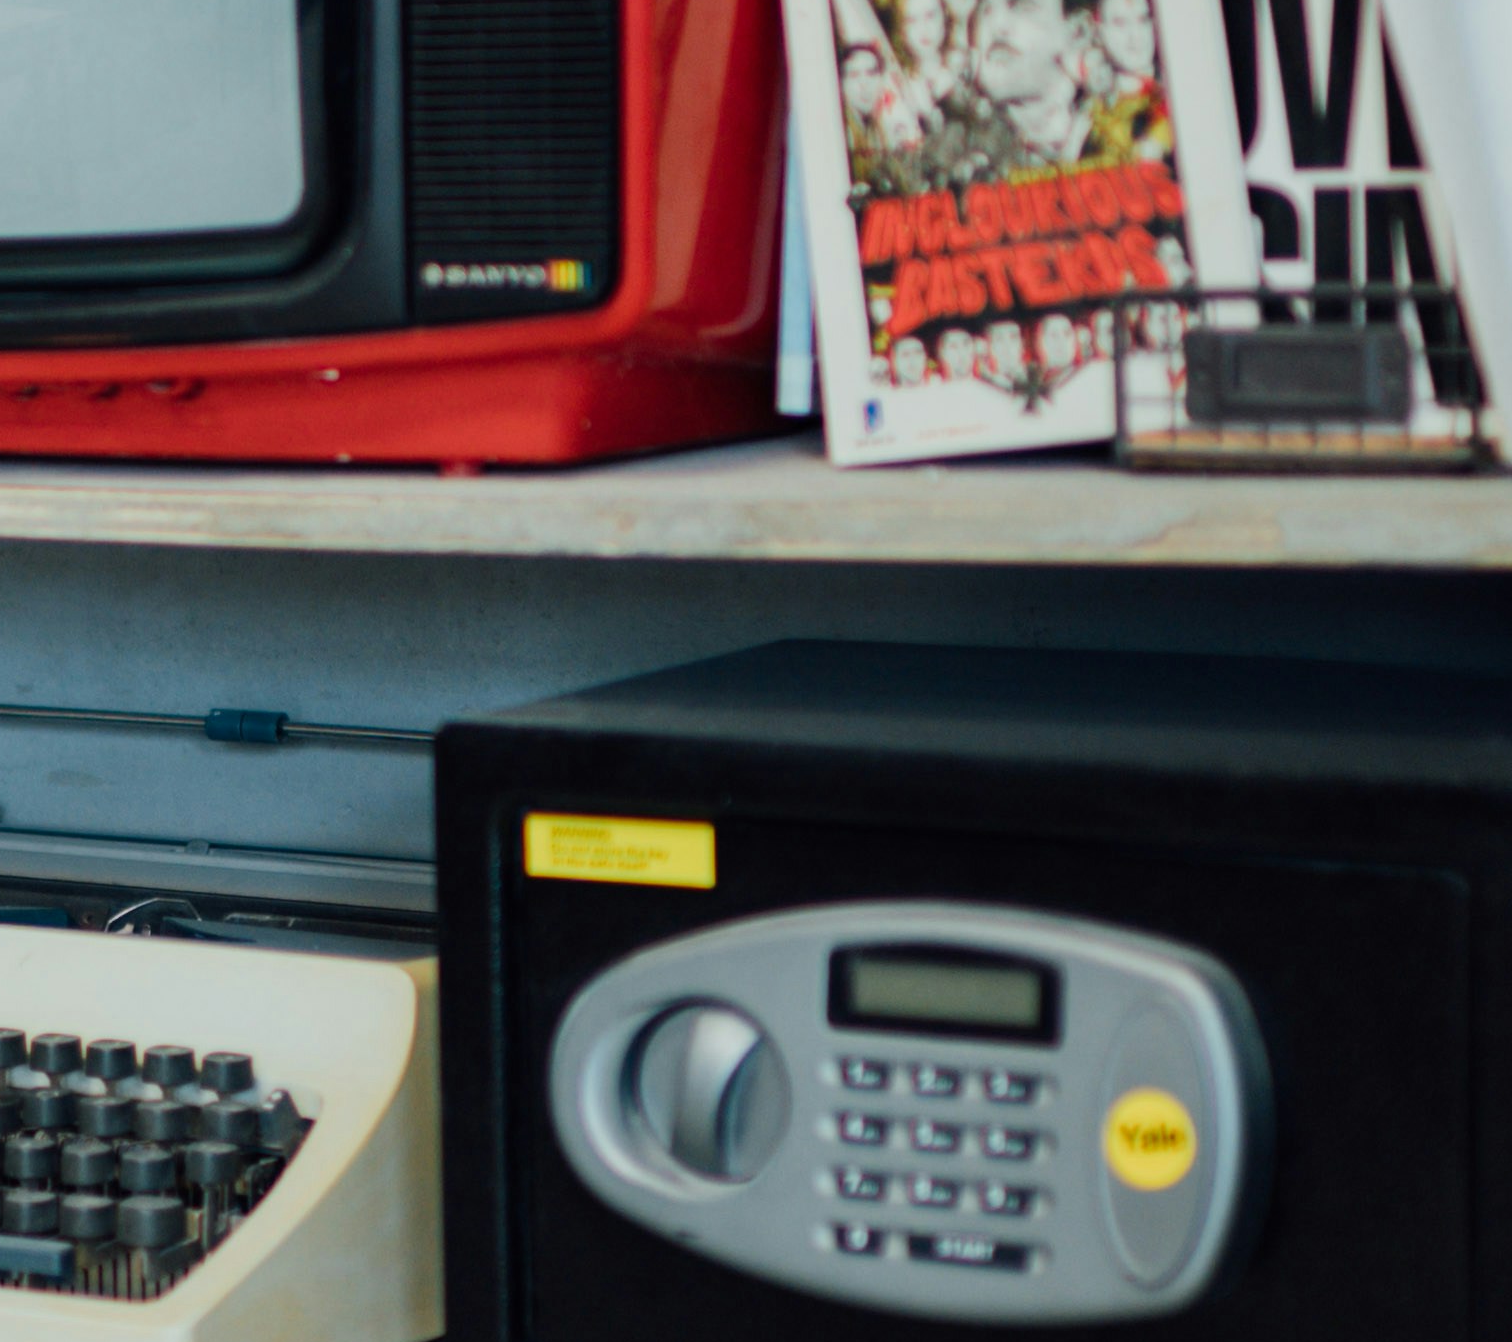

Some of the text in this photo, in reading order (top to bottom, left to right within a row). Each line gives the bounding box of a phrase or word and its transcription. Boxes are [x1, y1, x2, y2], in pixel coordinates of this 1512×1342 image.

[861, 161, 1183, 265] INGLOURIOUS
[445, 263, 546, 289] SANYO
[1118, 1122, 1185, 1155] Yale
